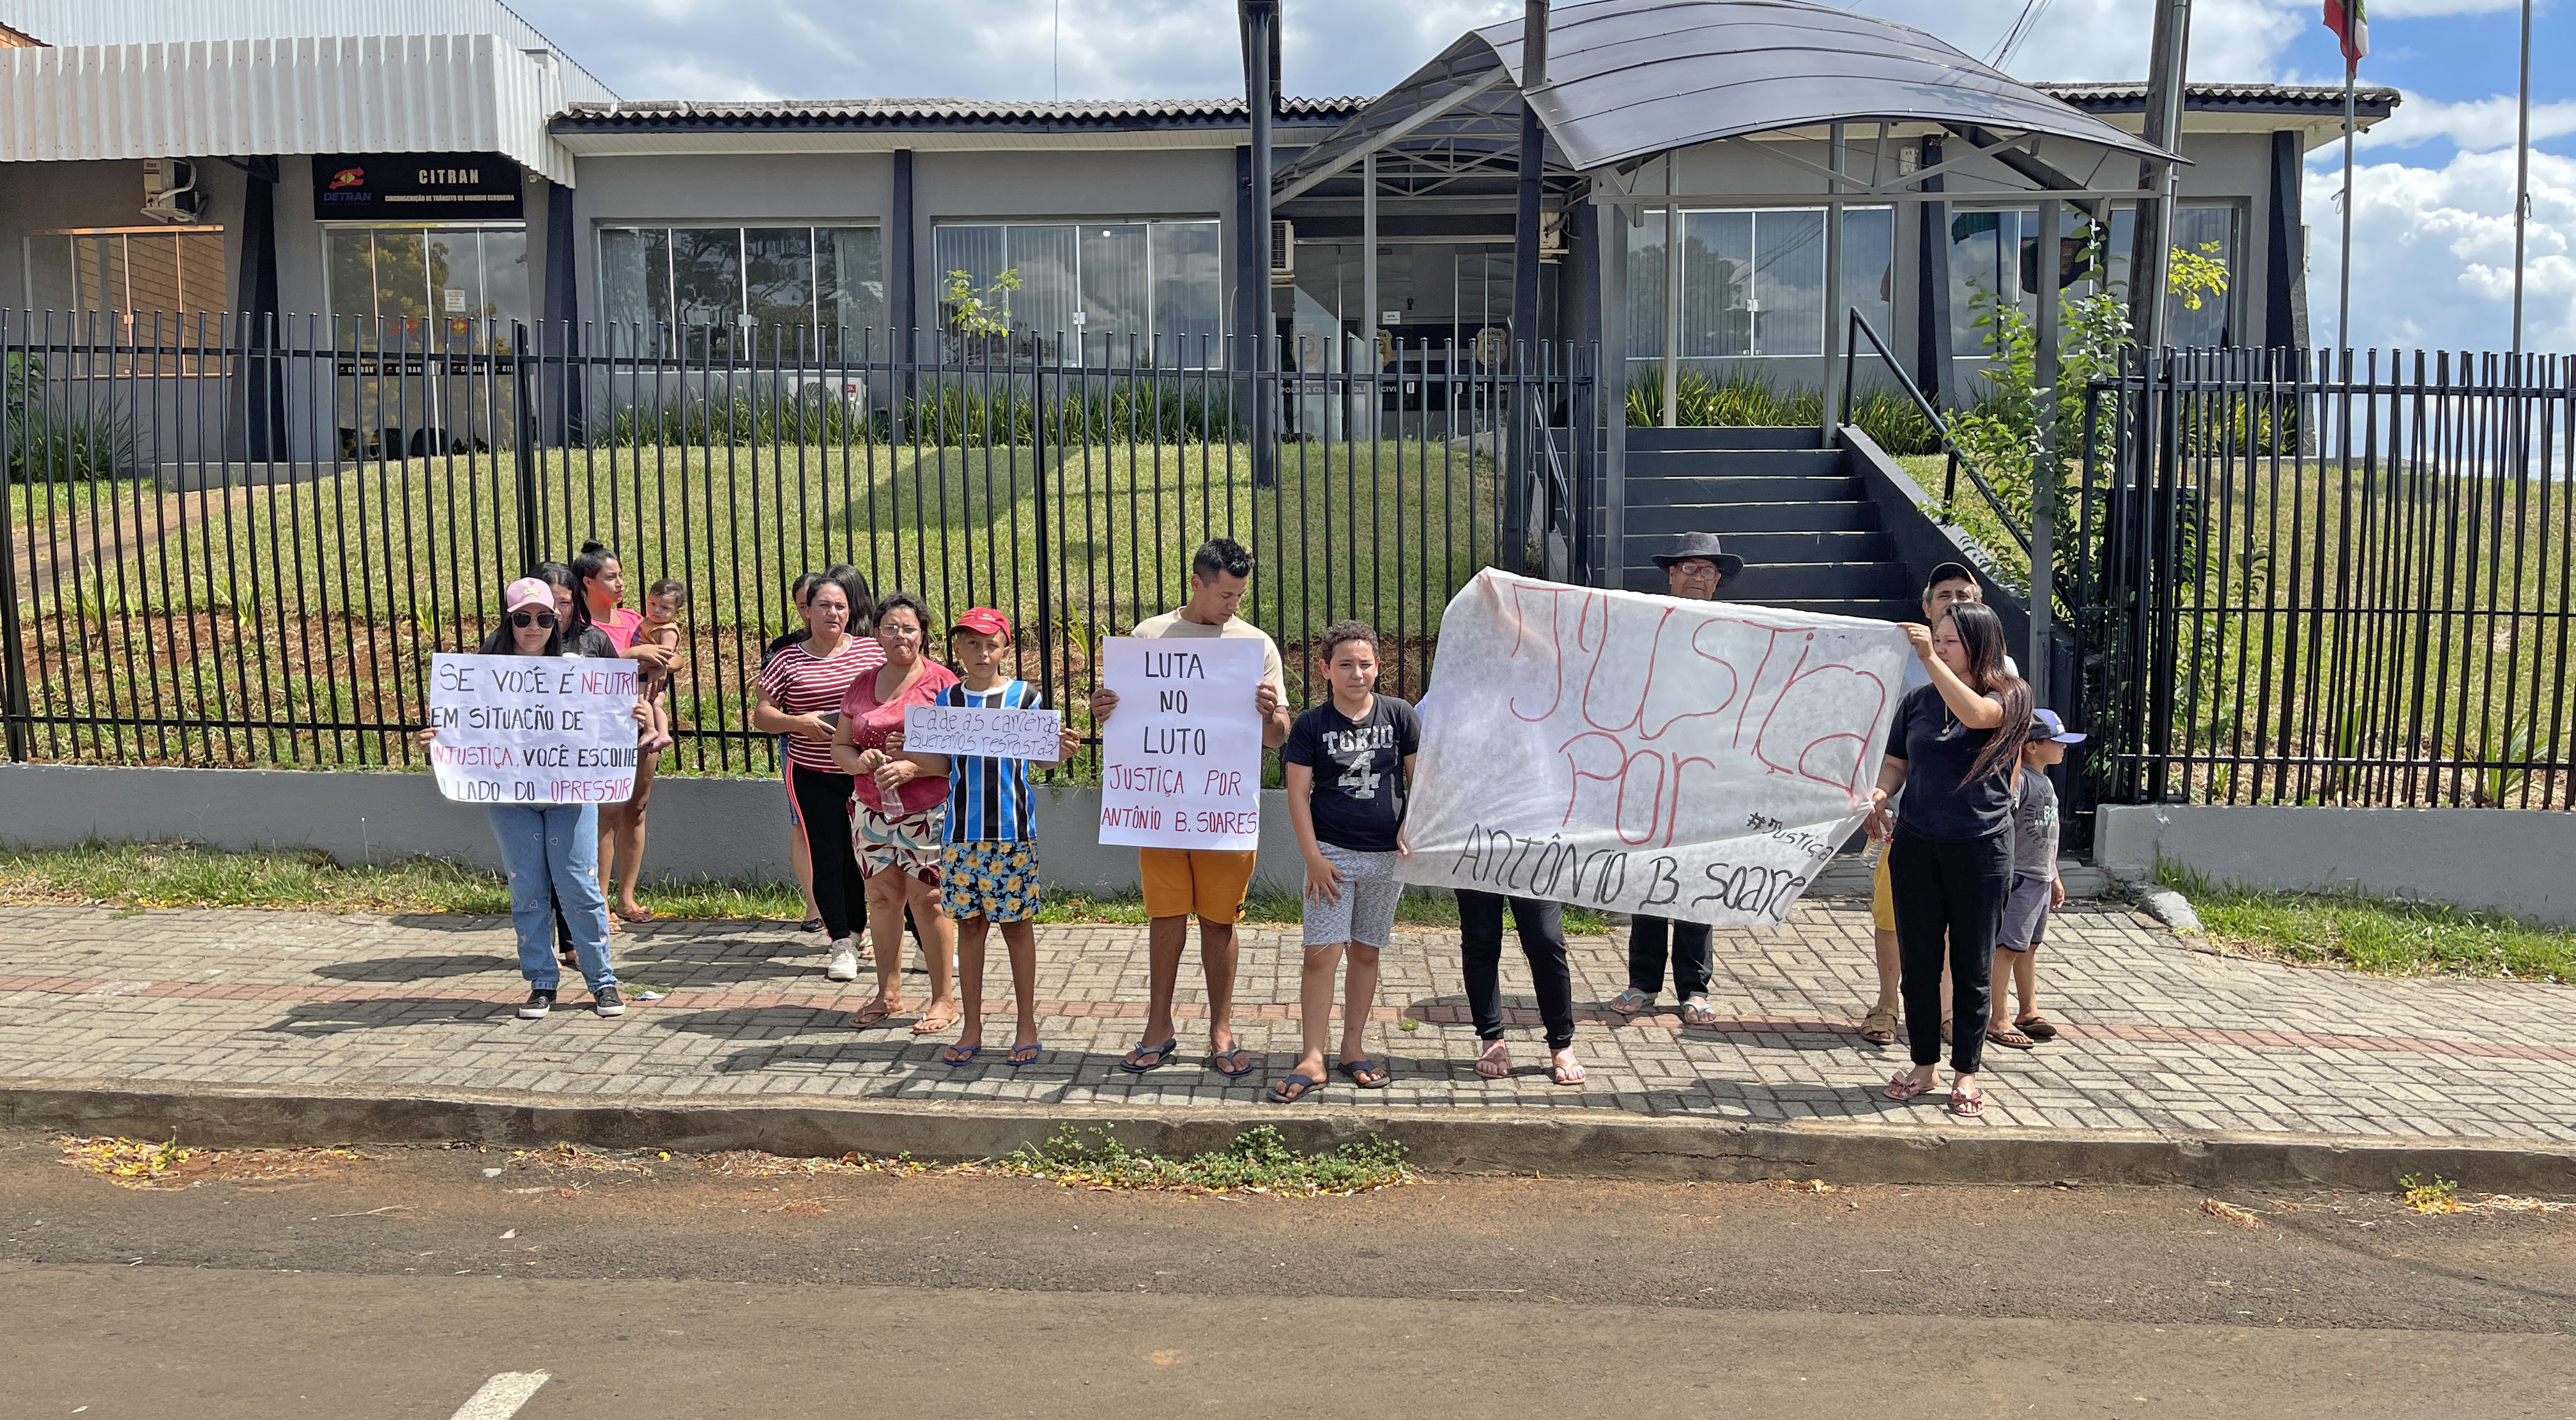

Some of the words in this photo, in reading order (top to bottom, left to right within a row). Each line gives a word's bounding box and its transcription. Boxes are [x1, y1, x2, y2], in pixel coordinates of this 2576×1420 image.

[419, 169, 479, 184] CITRAN
[323, 192, 372, 201] DETRAN
[1145, 651, 1204, 679] LUTA
[440, 663, 475, 691] SE
[492, 666, 549, 694] VOCÊ
[559, 666, 576, 694] É
[581, 672, 638, 696] NEUTRO
[1160, 690, 1188, 714] NO
[431, 706, 458, 729] EM
[562, 711, 584, 730] DE
[963, 713, 985, 732] as
[1144, 726, 1206, 755] LUTO
[1322, 725, 1394, 755] TOKIO
[523, 744, 569, 767] VOCÊ
[1204, 770, 1241, 796] POR
[1338, 750, 1381, 799] 4
[457, 780, 500, 801] LADO
[515, 781, 535, 801] DO
[551, 778, 632, 803] OPRESSOR
[1175, 812, 1191, 832] B.
[1197, 812, 1257, 834] SOARES
